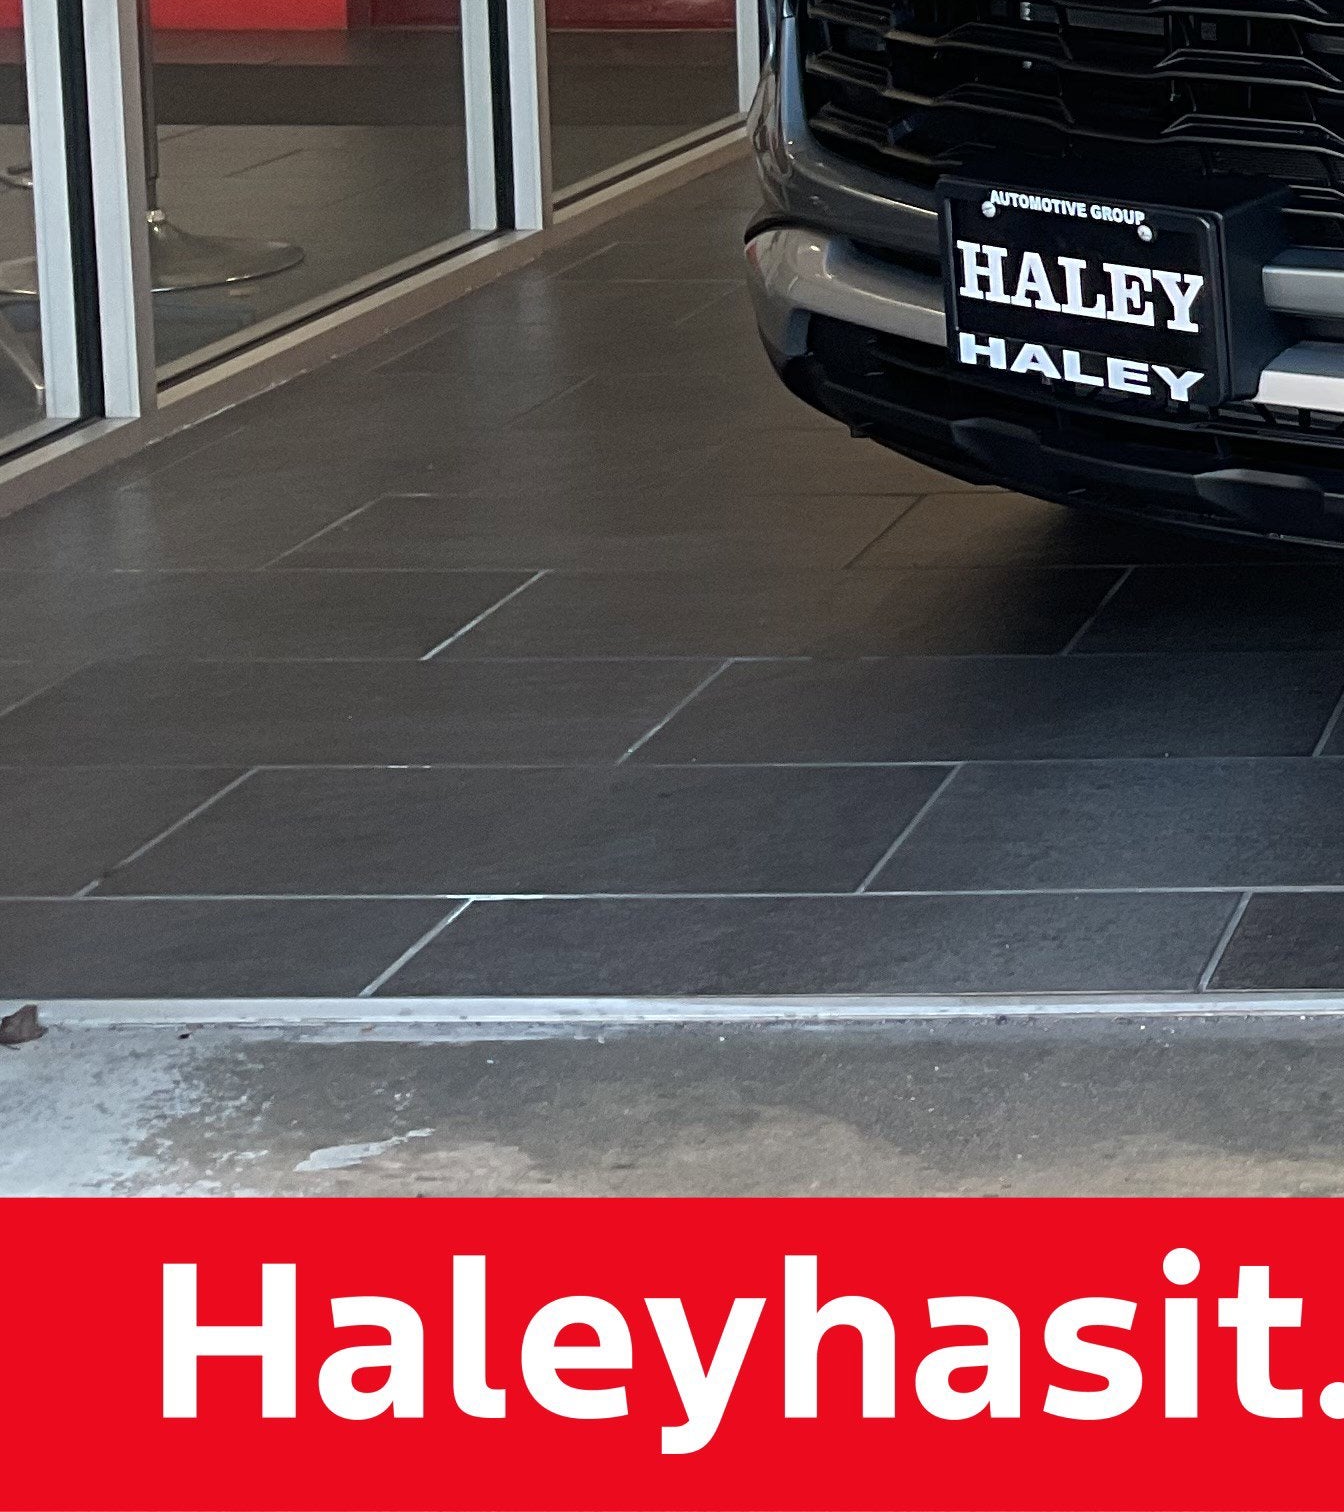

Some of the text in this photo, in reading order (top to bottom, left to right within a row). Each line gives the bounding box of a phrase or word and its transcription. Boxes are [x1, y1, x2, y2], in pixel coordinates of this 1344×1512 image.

[989, 189, 1146, 226] AUTOMOTIVE GROUP
[956, 239, 1204, 333] HALEY
[958, 331, 1205, 402] HALEY
